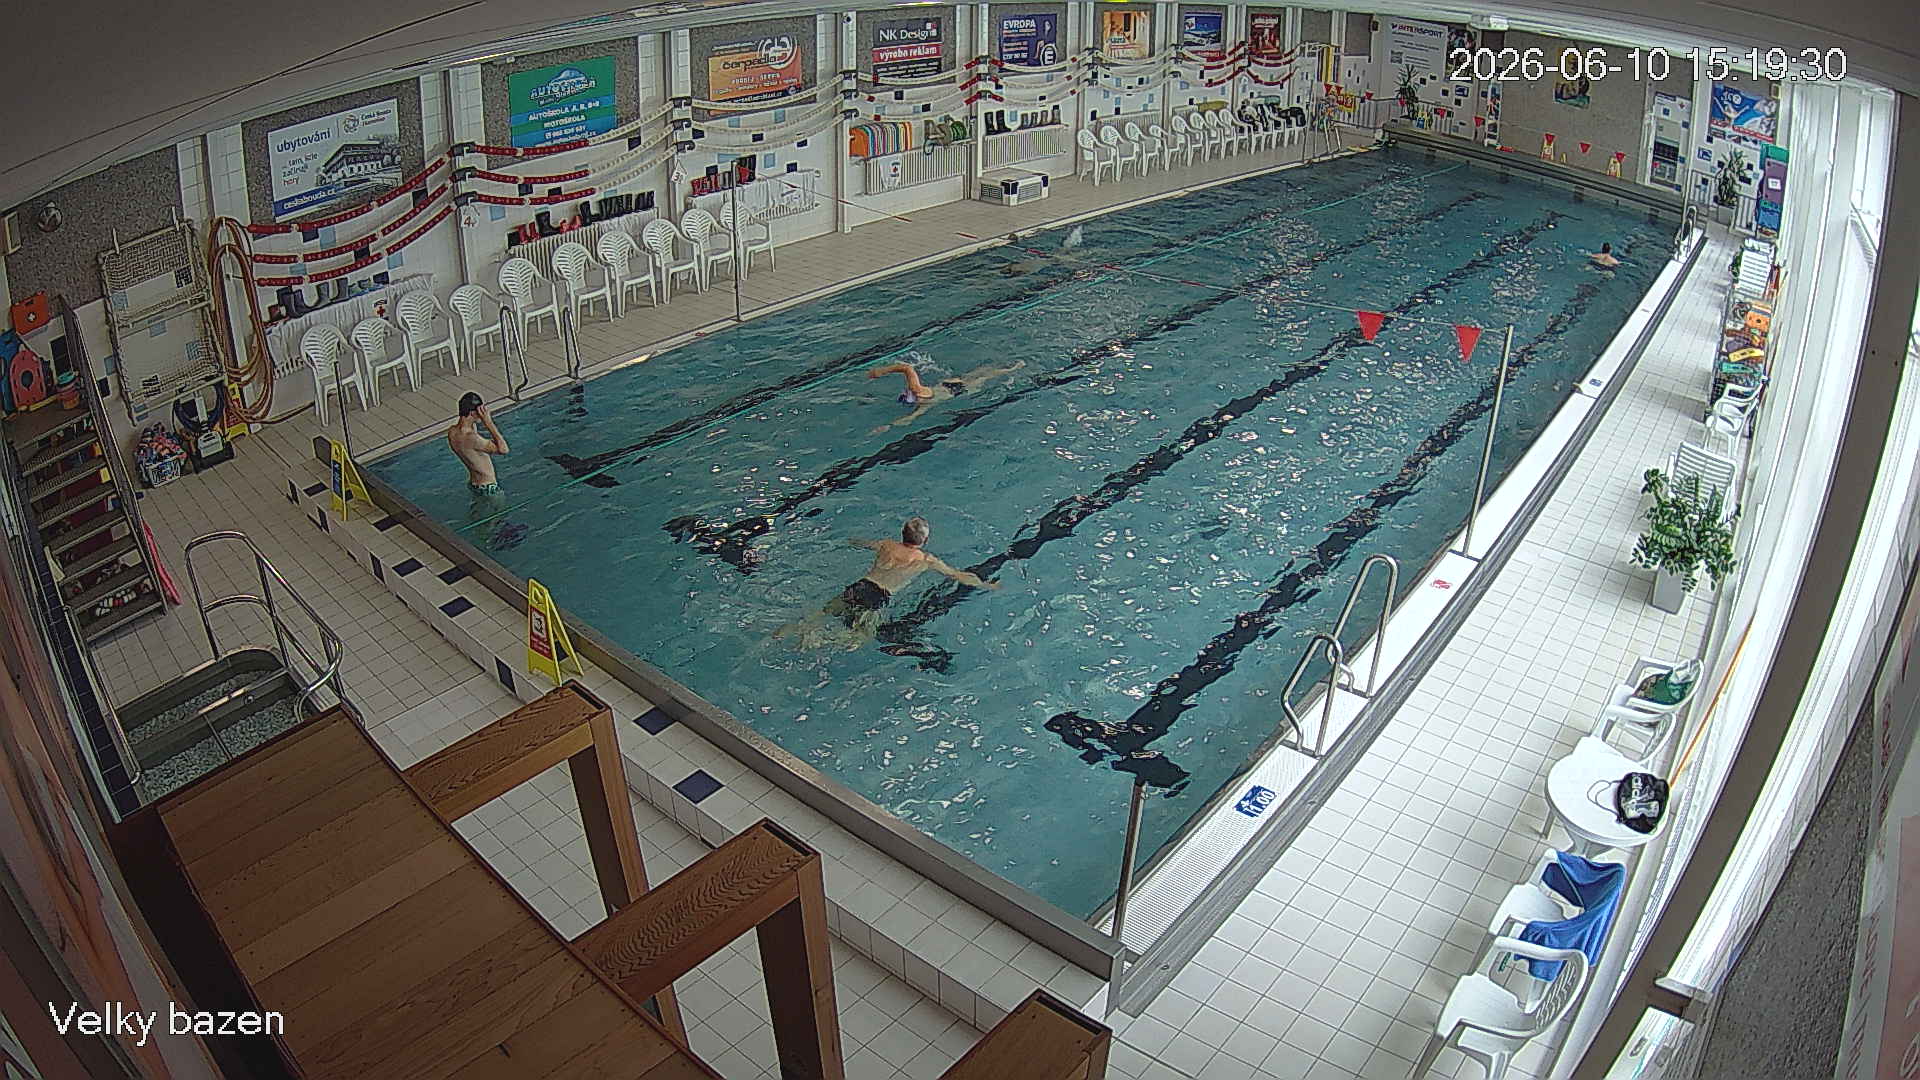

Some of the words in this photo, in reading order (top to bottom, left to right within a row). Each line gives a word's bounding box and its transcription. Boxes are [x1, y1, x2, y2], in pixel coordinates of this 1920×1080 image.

[1003, 19, 1036, 30] EVROPA
[879, 28, 898, 41] NK
[900, 28, 936, 40] Design
[909, 46, 937, 57] reklam
[276, 128, 332, 154] ubytování
